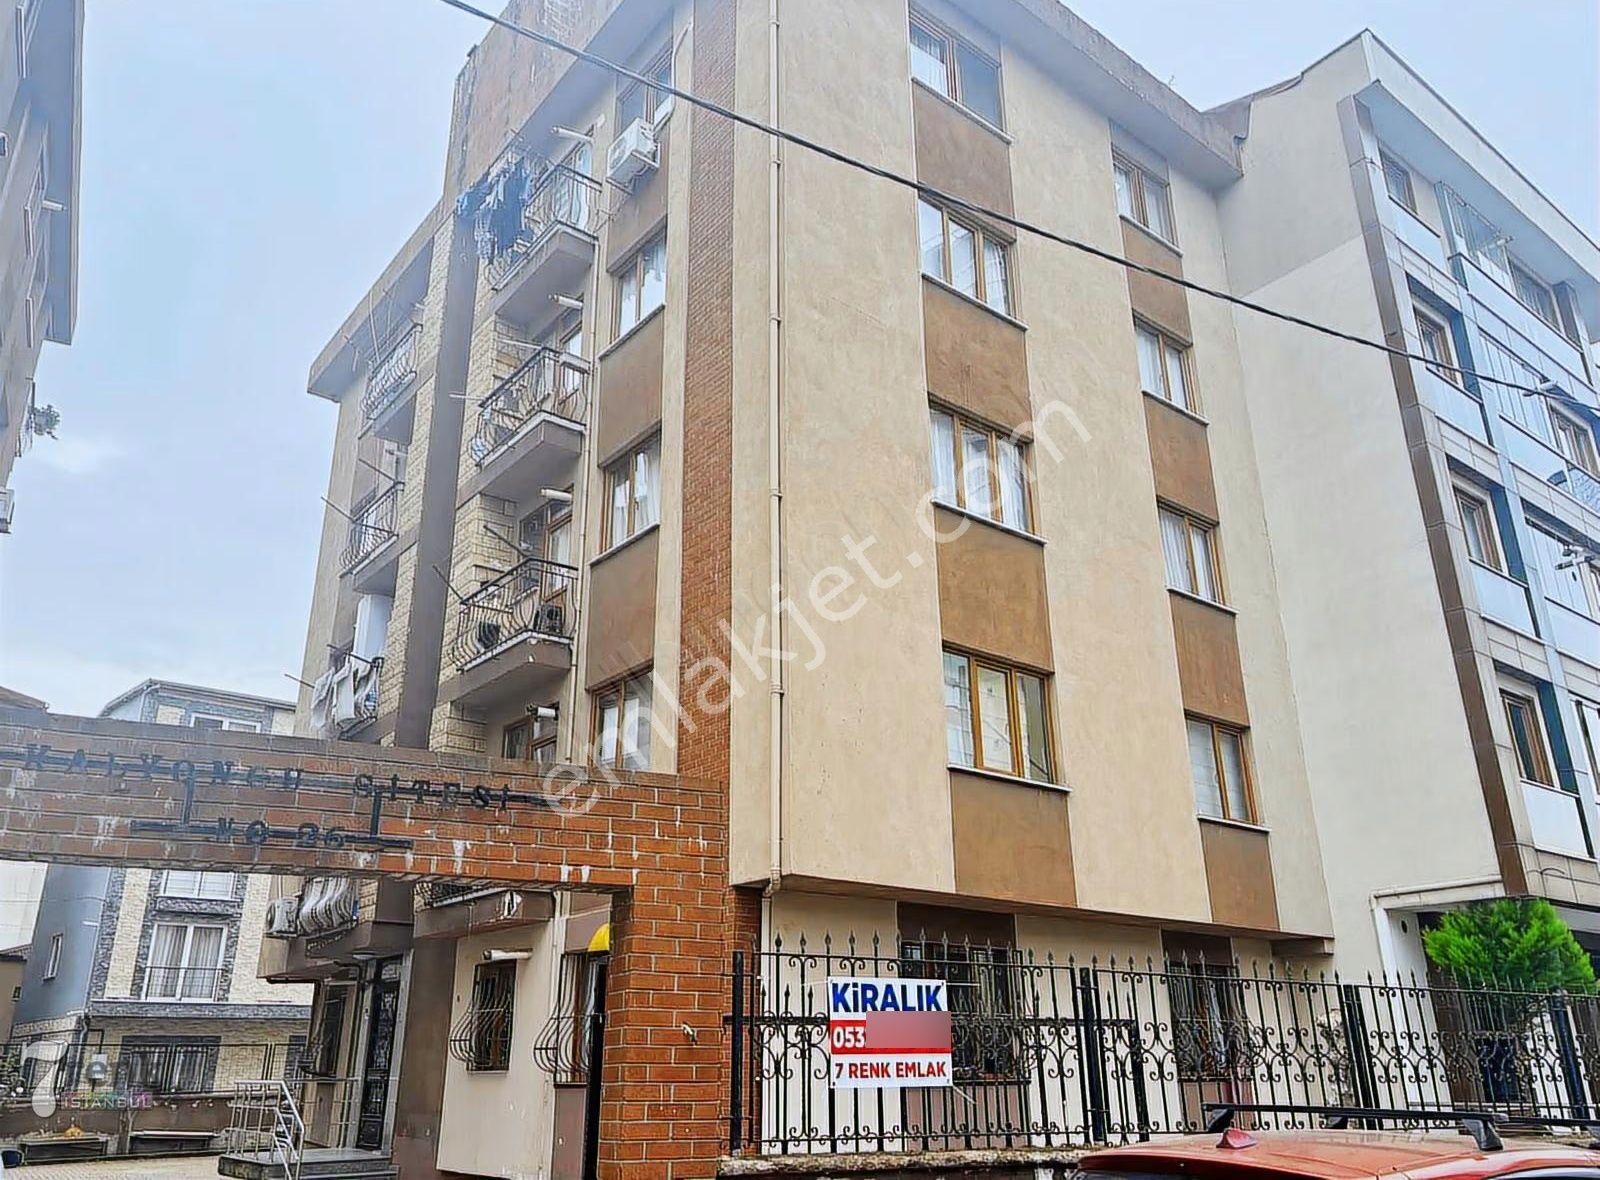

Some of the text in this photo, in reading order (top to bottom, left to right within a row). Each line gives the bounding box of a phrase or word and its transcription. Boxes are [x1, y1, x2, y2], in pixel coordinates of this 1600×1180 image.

[834, 1061, 947, 1079] 7 RENK EMLAK
